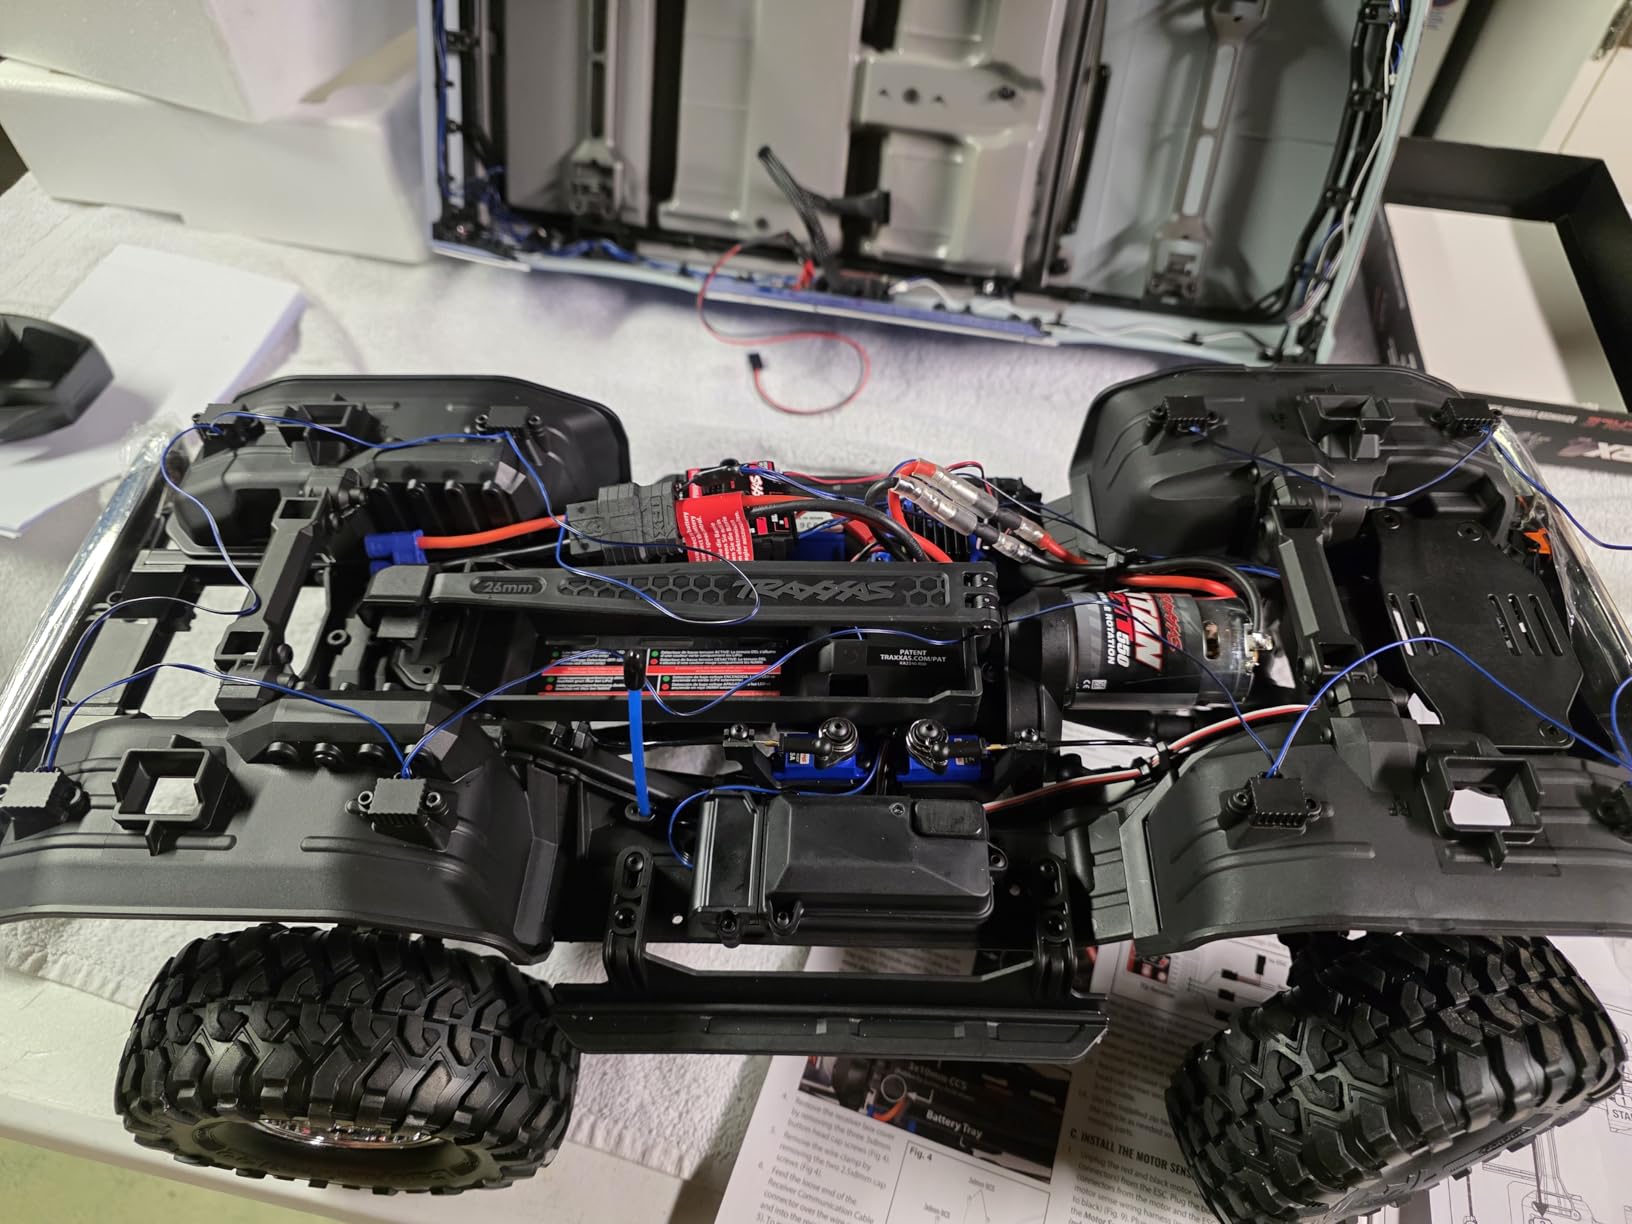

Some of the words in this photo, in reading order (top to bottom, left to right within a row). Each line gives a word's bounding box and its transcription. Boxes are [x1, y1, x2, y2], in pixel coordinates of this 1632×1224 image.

[483, 581, 534, 593] 26mm
[732, 578, 897, 602] TRAXXAS
[1105, 613, 1116, 665] ROTATION
[1116, 631, 1130, 668] 550
[926, 1110, 962, 1132] Battery
[962, 1122, 984, 1138] Tray
[1612, 1109, 1632, 1120] STA
[909, 1146, 926, 1159] Fig.
[1081, 1133, 1115, 1151] INSTALL
[1118, 1144, 1134, 1158] THE
[1136, 1151, 1168, 1170] MOTOR
[798, 1190, 853, 1216] Communication
